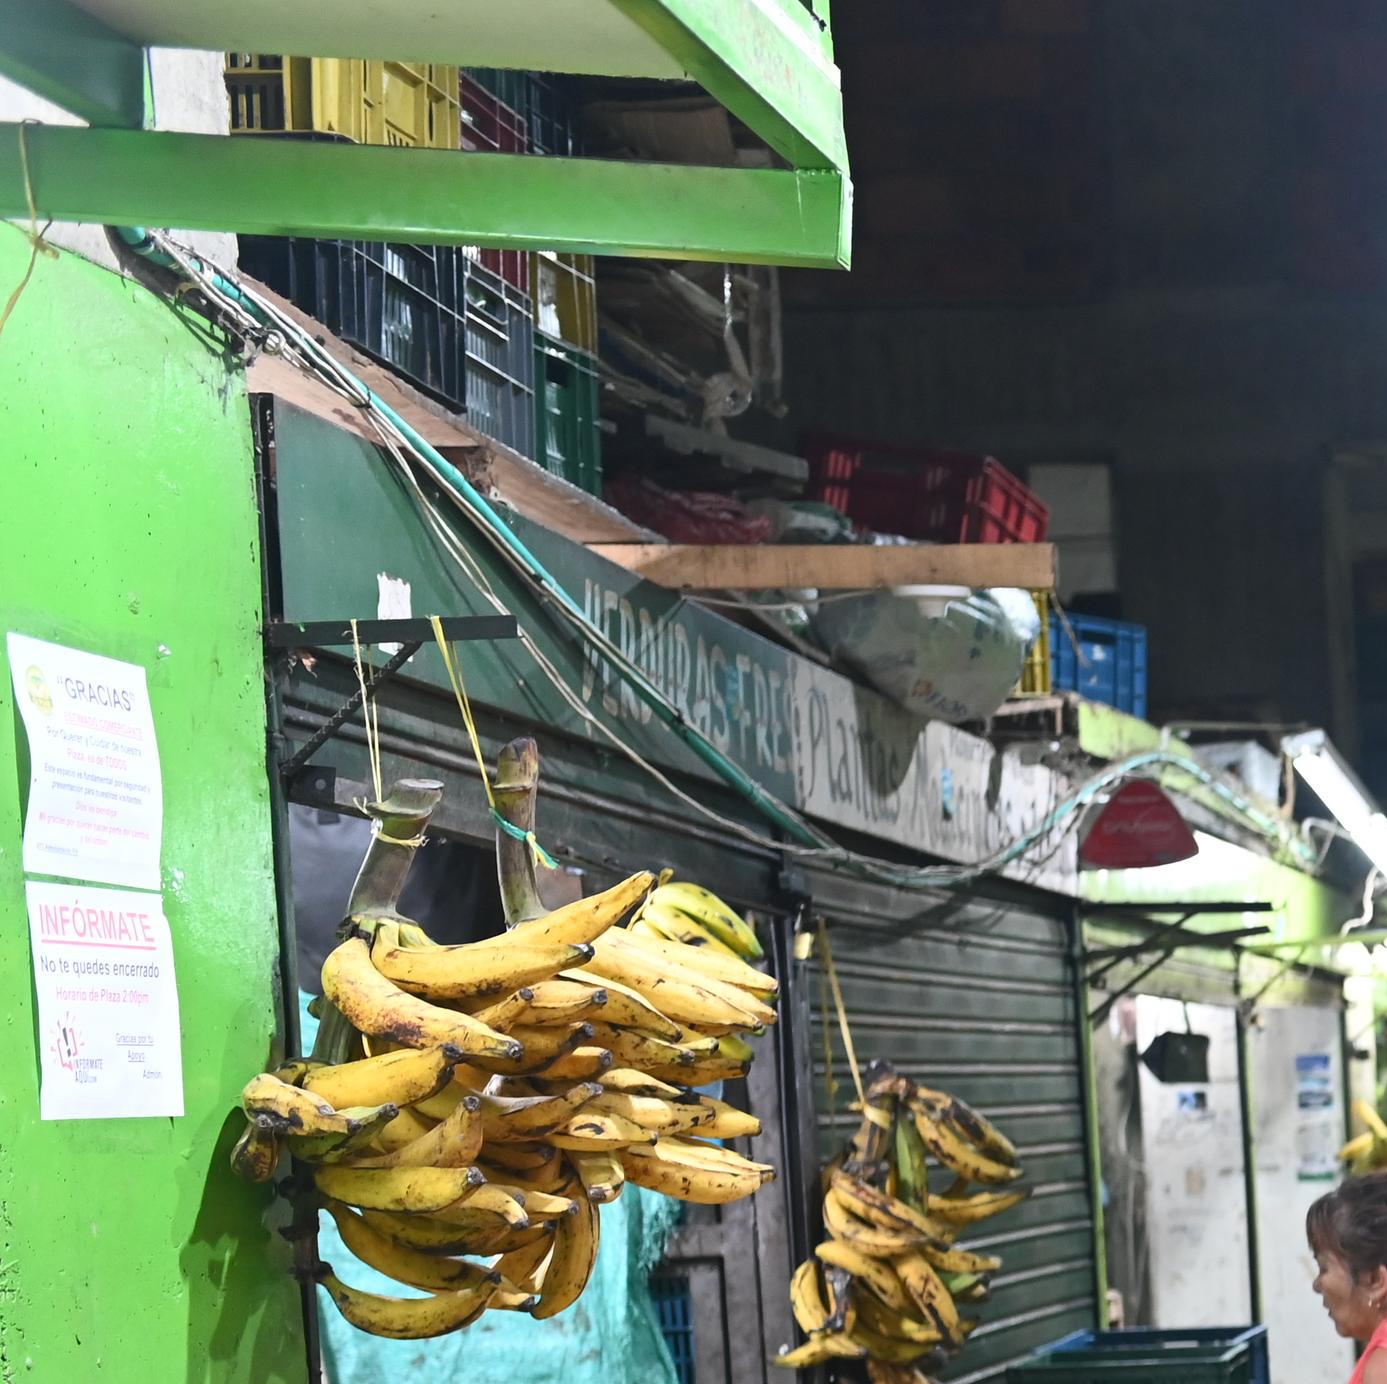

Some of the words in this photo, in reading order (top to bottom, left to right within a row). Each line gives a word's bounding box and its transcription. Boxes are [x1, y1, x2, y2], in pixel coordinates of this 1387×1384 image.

[807, 687, 900, 824] Plantas
[39, 899, 155, 942] INFÓRMATE
[40, 955, 57, 973] No
[59, 957, 70, 973] te
[72, 958, 110, 979] quedes
[113, 962, 160, 978] encerrado
[56, 986, 87, 1001] Horario
[89, 988, 99, 1002] de
[100, 988, 121, 1003] Plaza
